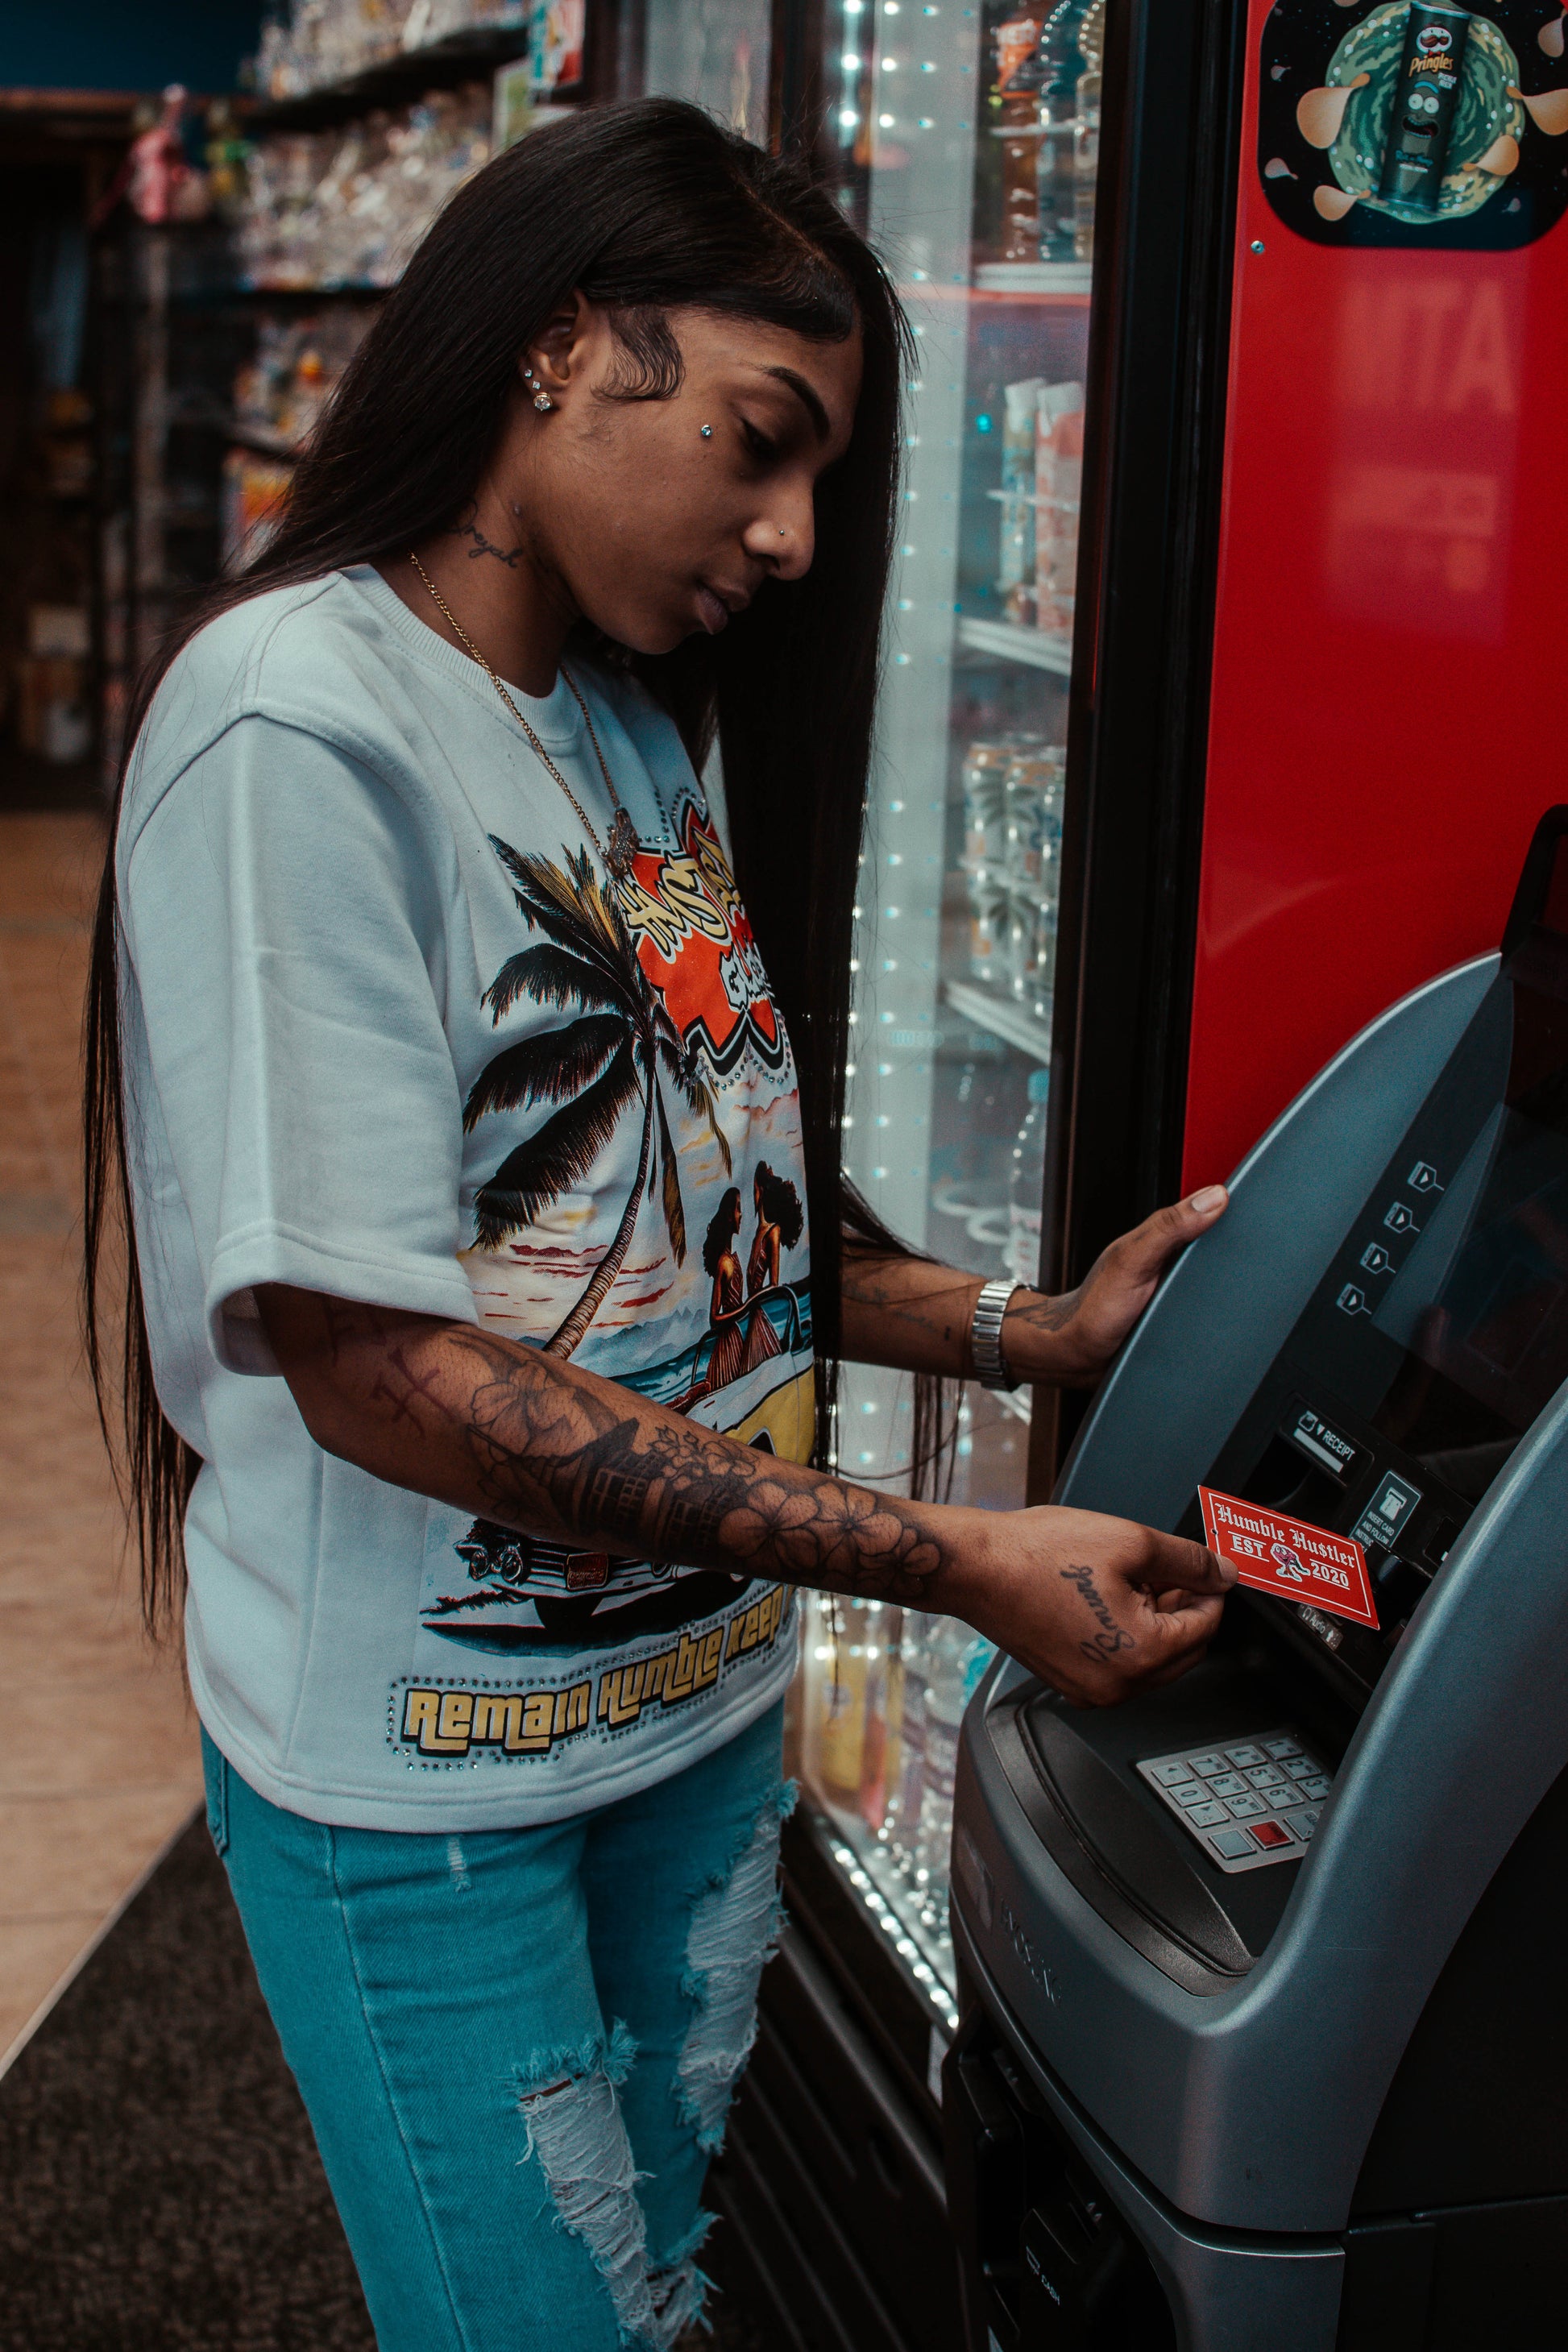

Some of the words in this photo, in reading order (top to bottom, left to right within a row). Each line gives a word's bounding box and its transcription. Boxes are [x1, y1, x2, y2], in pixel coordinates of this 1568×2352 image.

[1408, 52, 1454, 77] Pringles
[1322, 1430, 1356, 1461] RECEIPT
[1214, 1502, 1285, 1543] Humble
[1361, 1520, 1373, 1532] AND
[1370, 1527, 1390, 1545] FOLLOW
[1366, 1510, 1383, 1527] INSERT
[1380, 1521, 1396, 1537] CARD
[1232, 1535, 1263, 1558] EST
[1311, 1562, 1349, 1588] 2020
[1309, 1614, 1327, 1634] Audio
[1181, 1790, 1197, 1798] 0
[1305, 1780, 1322, 1788] 3
[1231, 1798, 1247, 1806] 9
